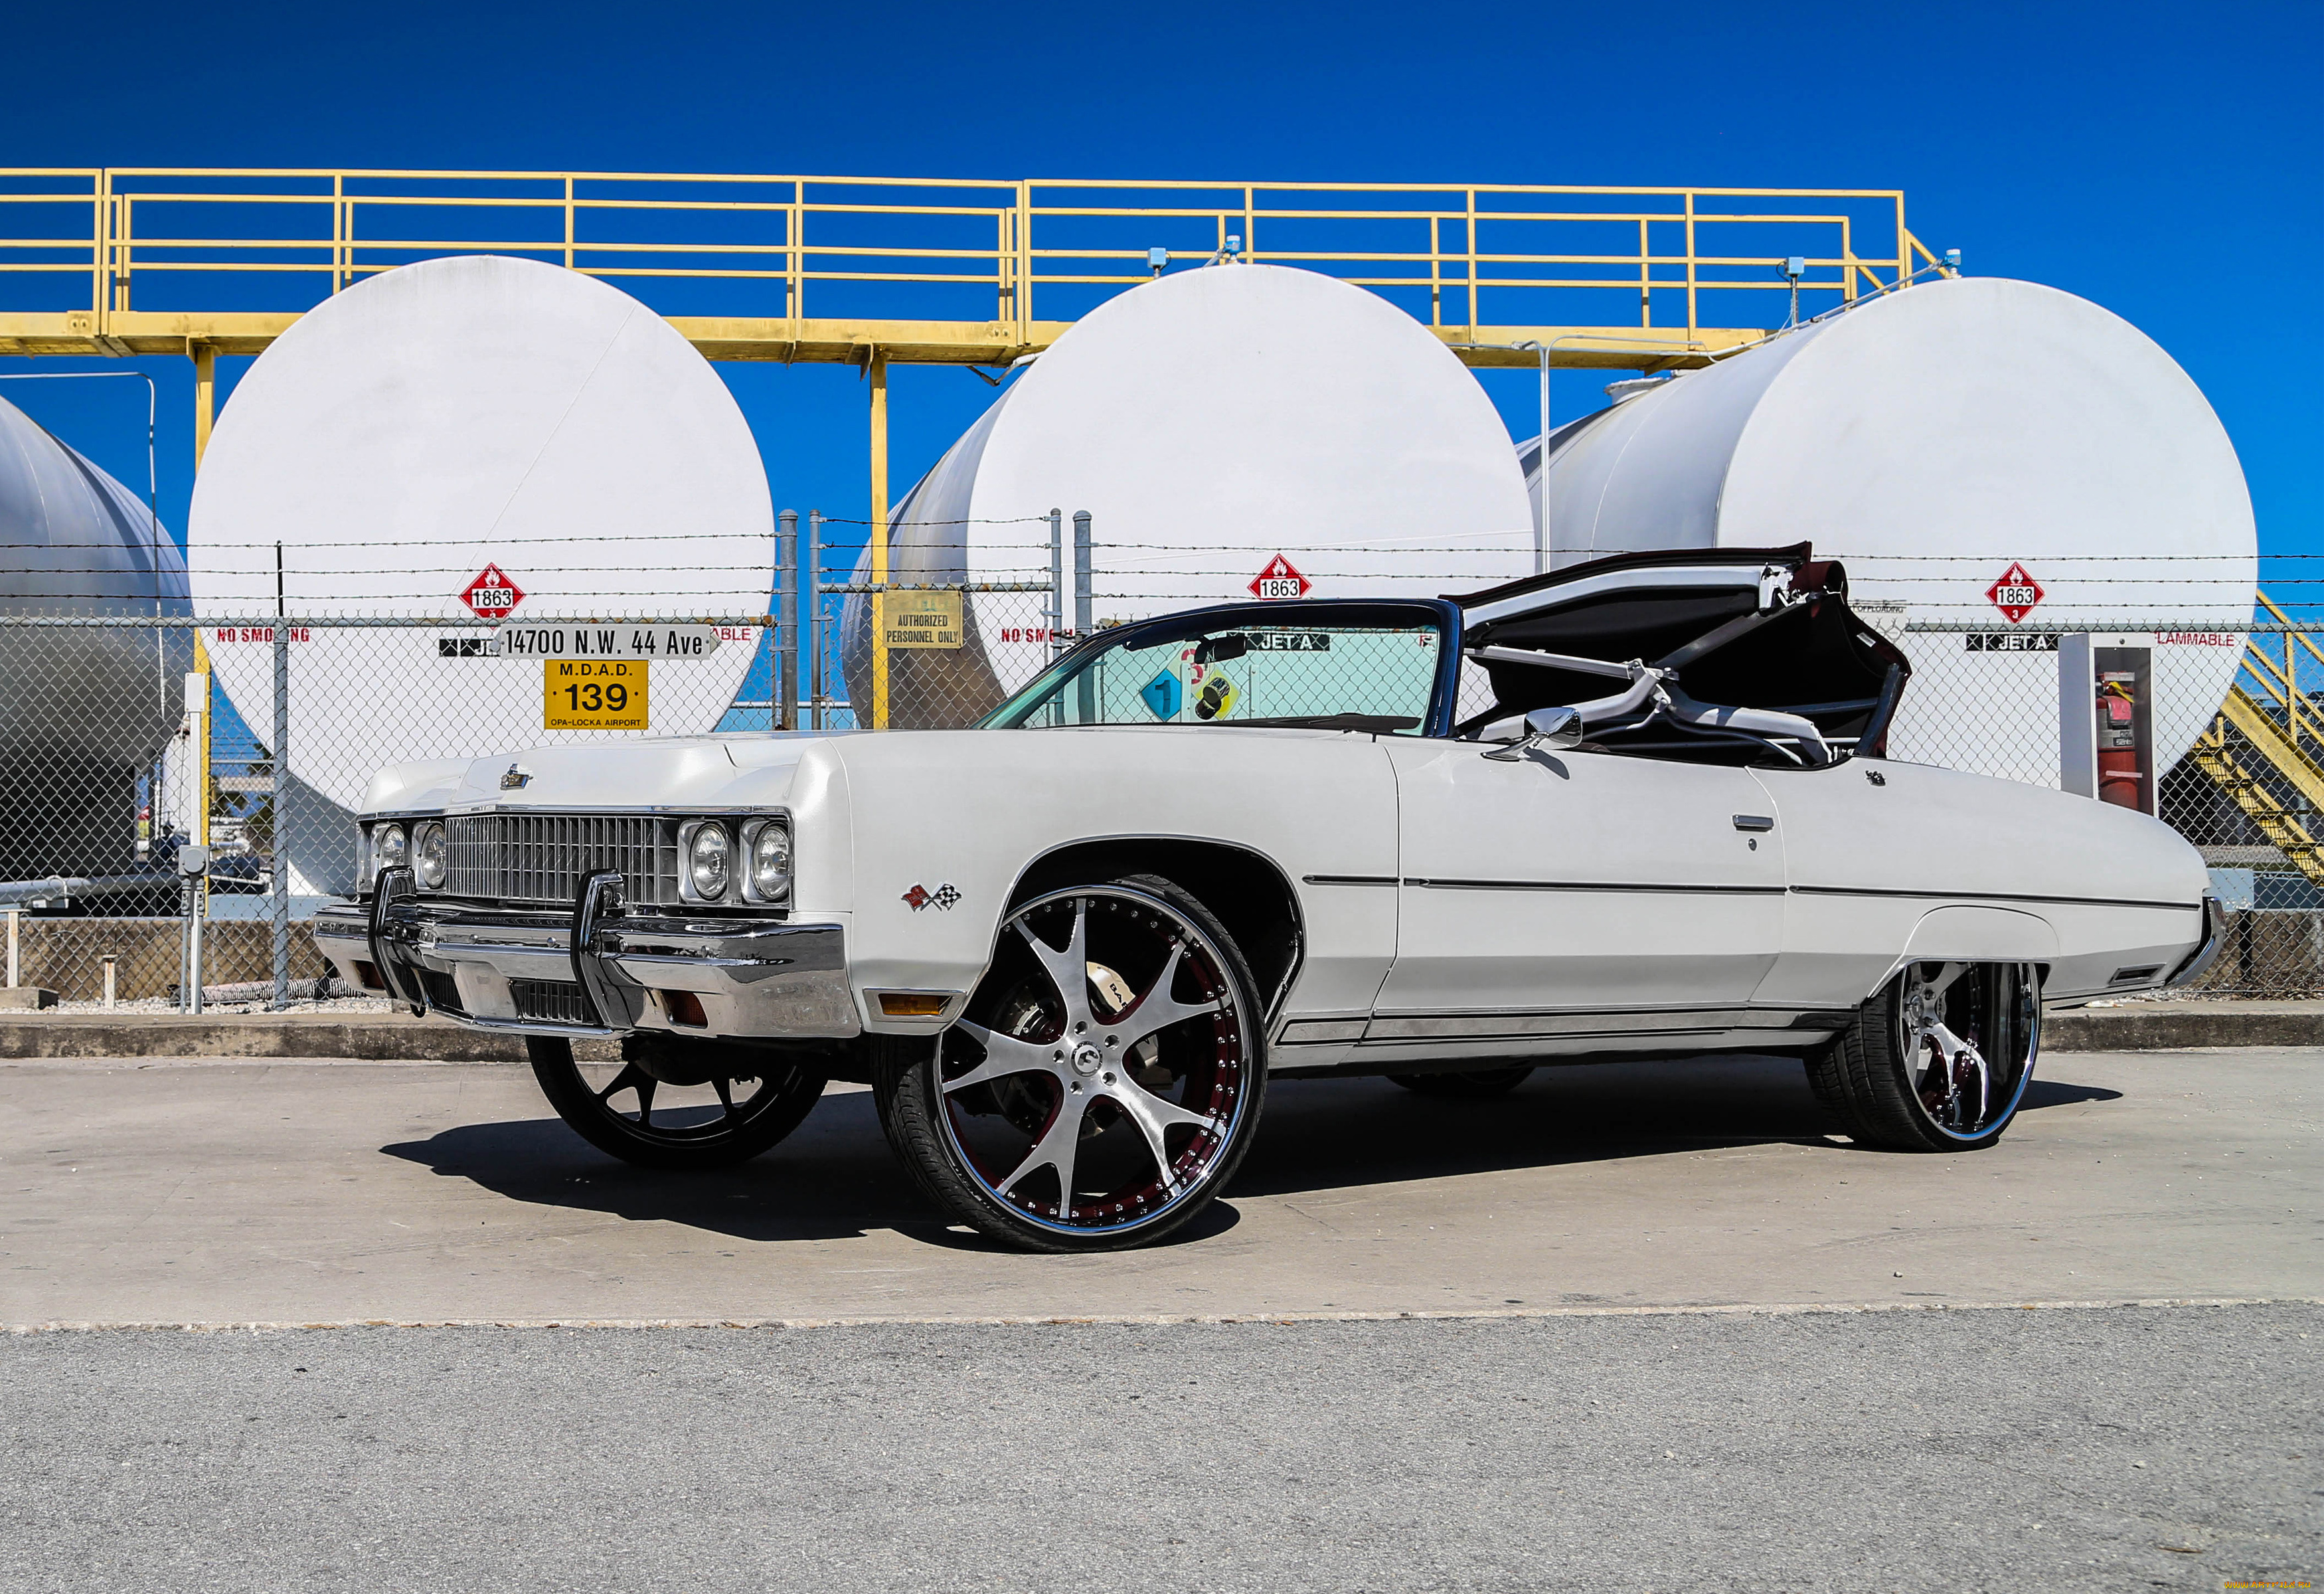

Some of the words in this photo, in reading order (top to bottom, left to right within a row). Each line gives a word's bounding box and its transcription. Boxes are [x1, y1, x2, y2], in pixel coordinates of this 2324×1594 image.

[1262, 580, 1299, 596] 1863
[1998, 588, 2033, 604] 1863
[473, 590, 512, 606] 1863
[898, 614, 948, 627] AUTHORIZED
[2012, 609, 2019, 618] 3
[217, 628, 236, 642] NO
[241, 628, 309, 642] SMONG
[506, 629, 564, 654] 14700
[575, 630, 622, 654] N.W.
[631, 630, 656, 654] 44
[666, 630, 703, 655] Ave
[886, 630, 934, 643] PERSONNEL
[938, 631, 958, 643] ONLY
[1001, 628, 1020, 642] NO
[1262, 634, 1295, 650] JET
[1299, 634, 1313, 650] A
[1999, 635, 2031, 650] JET
[2034, 634, 2048, 650] A
[2155, 631, 2234, 646] LAMMABLE
[560, 664, 633, 676] M.D.A.D.
[564, 683, 627, 711] 139
[1155, 679, 1171, 713] 1
